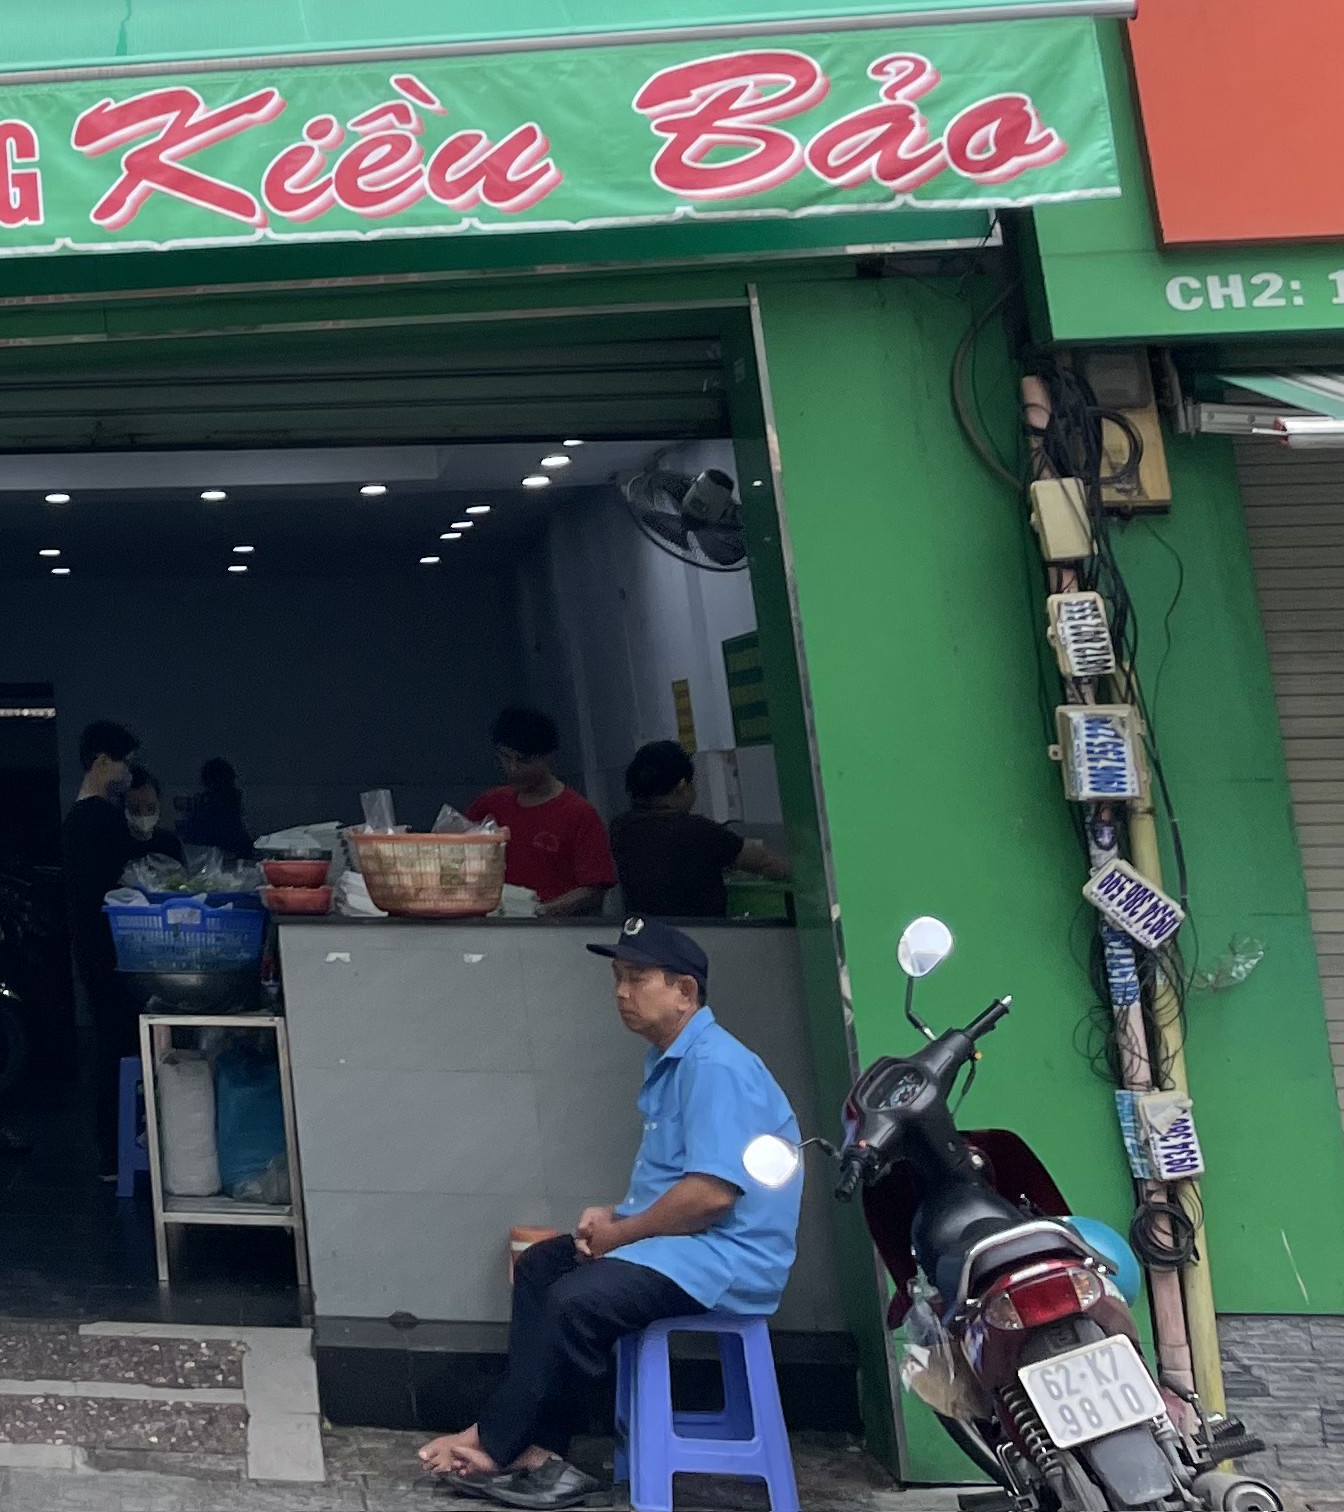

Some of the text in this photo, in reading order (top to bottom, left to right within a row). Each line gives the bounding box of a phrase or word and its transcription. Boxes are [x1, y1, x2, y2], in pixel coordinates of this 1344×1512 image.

[69, 73, 563, 230] Kiều
[632, 48, 1066, 204] Bảo
[1168, 274, 1302, 309] CH2:
[1058, 1383, 1145, 1436] 9810
